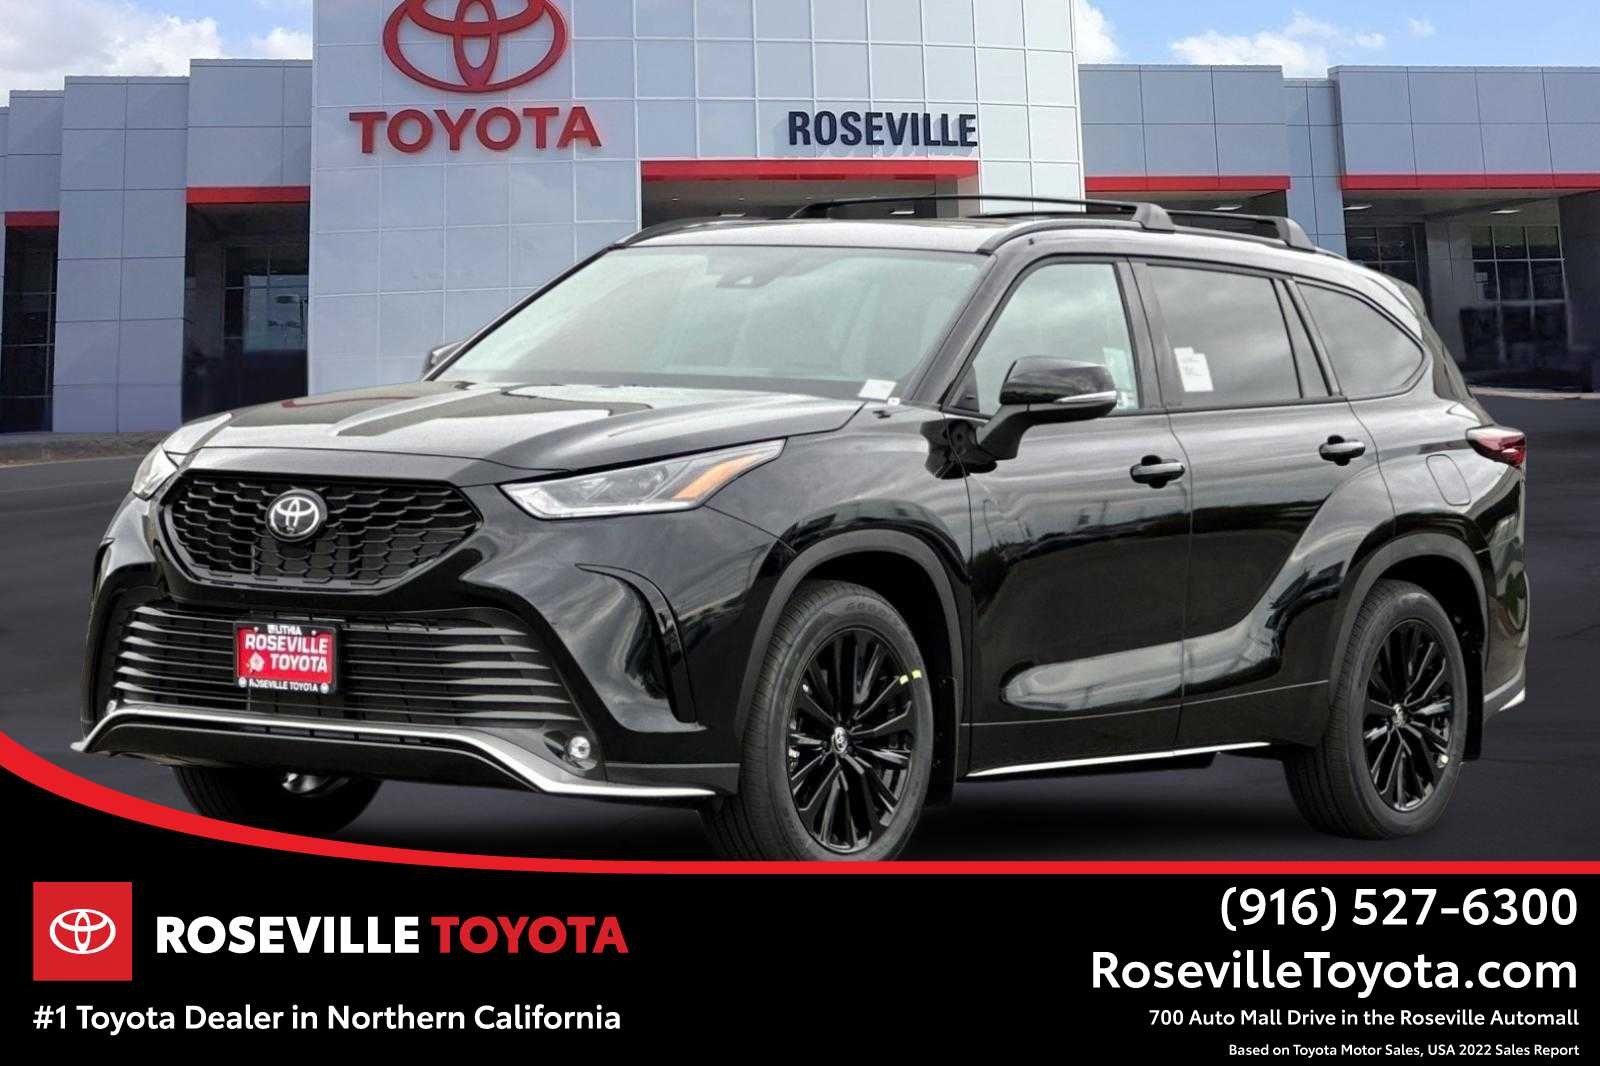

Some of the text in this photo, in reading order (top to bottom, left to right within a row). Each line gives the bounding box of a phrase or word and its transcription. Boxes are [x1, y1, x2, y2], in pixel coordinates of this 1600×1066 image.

[349, 106, 602, 154] TOYOTA
[788, 111, 978, 147] ROSEVILLE
[245, 634, 328, 654] ROSEVILLE
[270, 653, 328, 673] TOYOTA
[290, 682, 318, 692] TOYOTA
